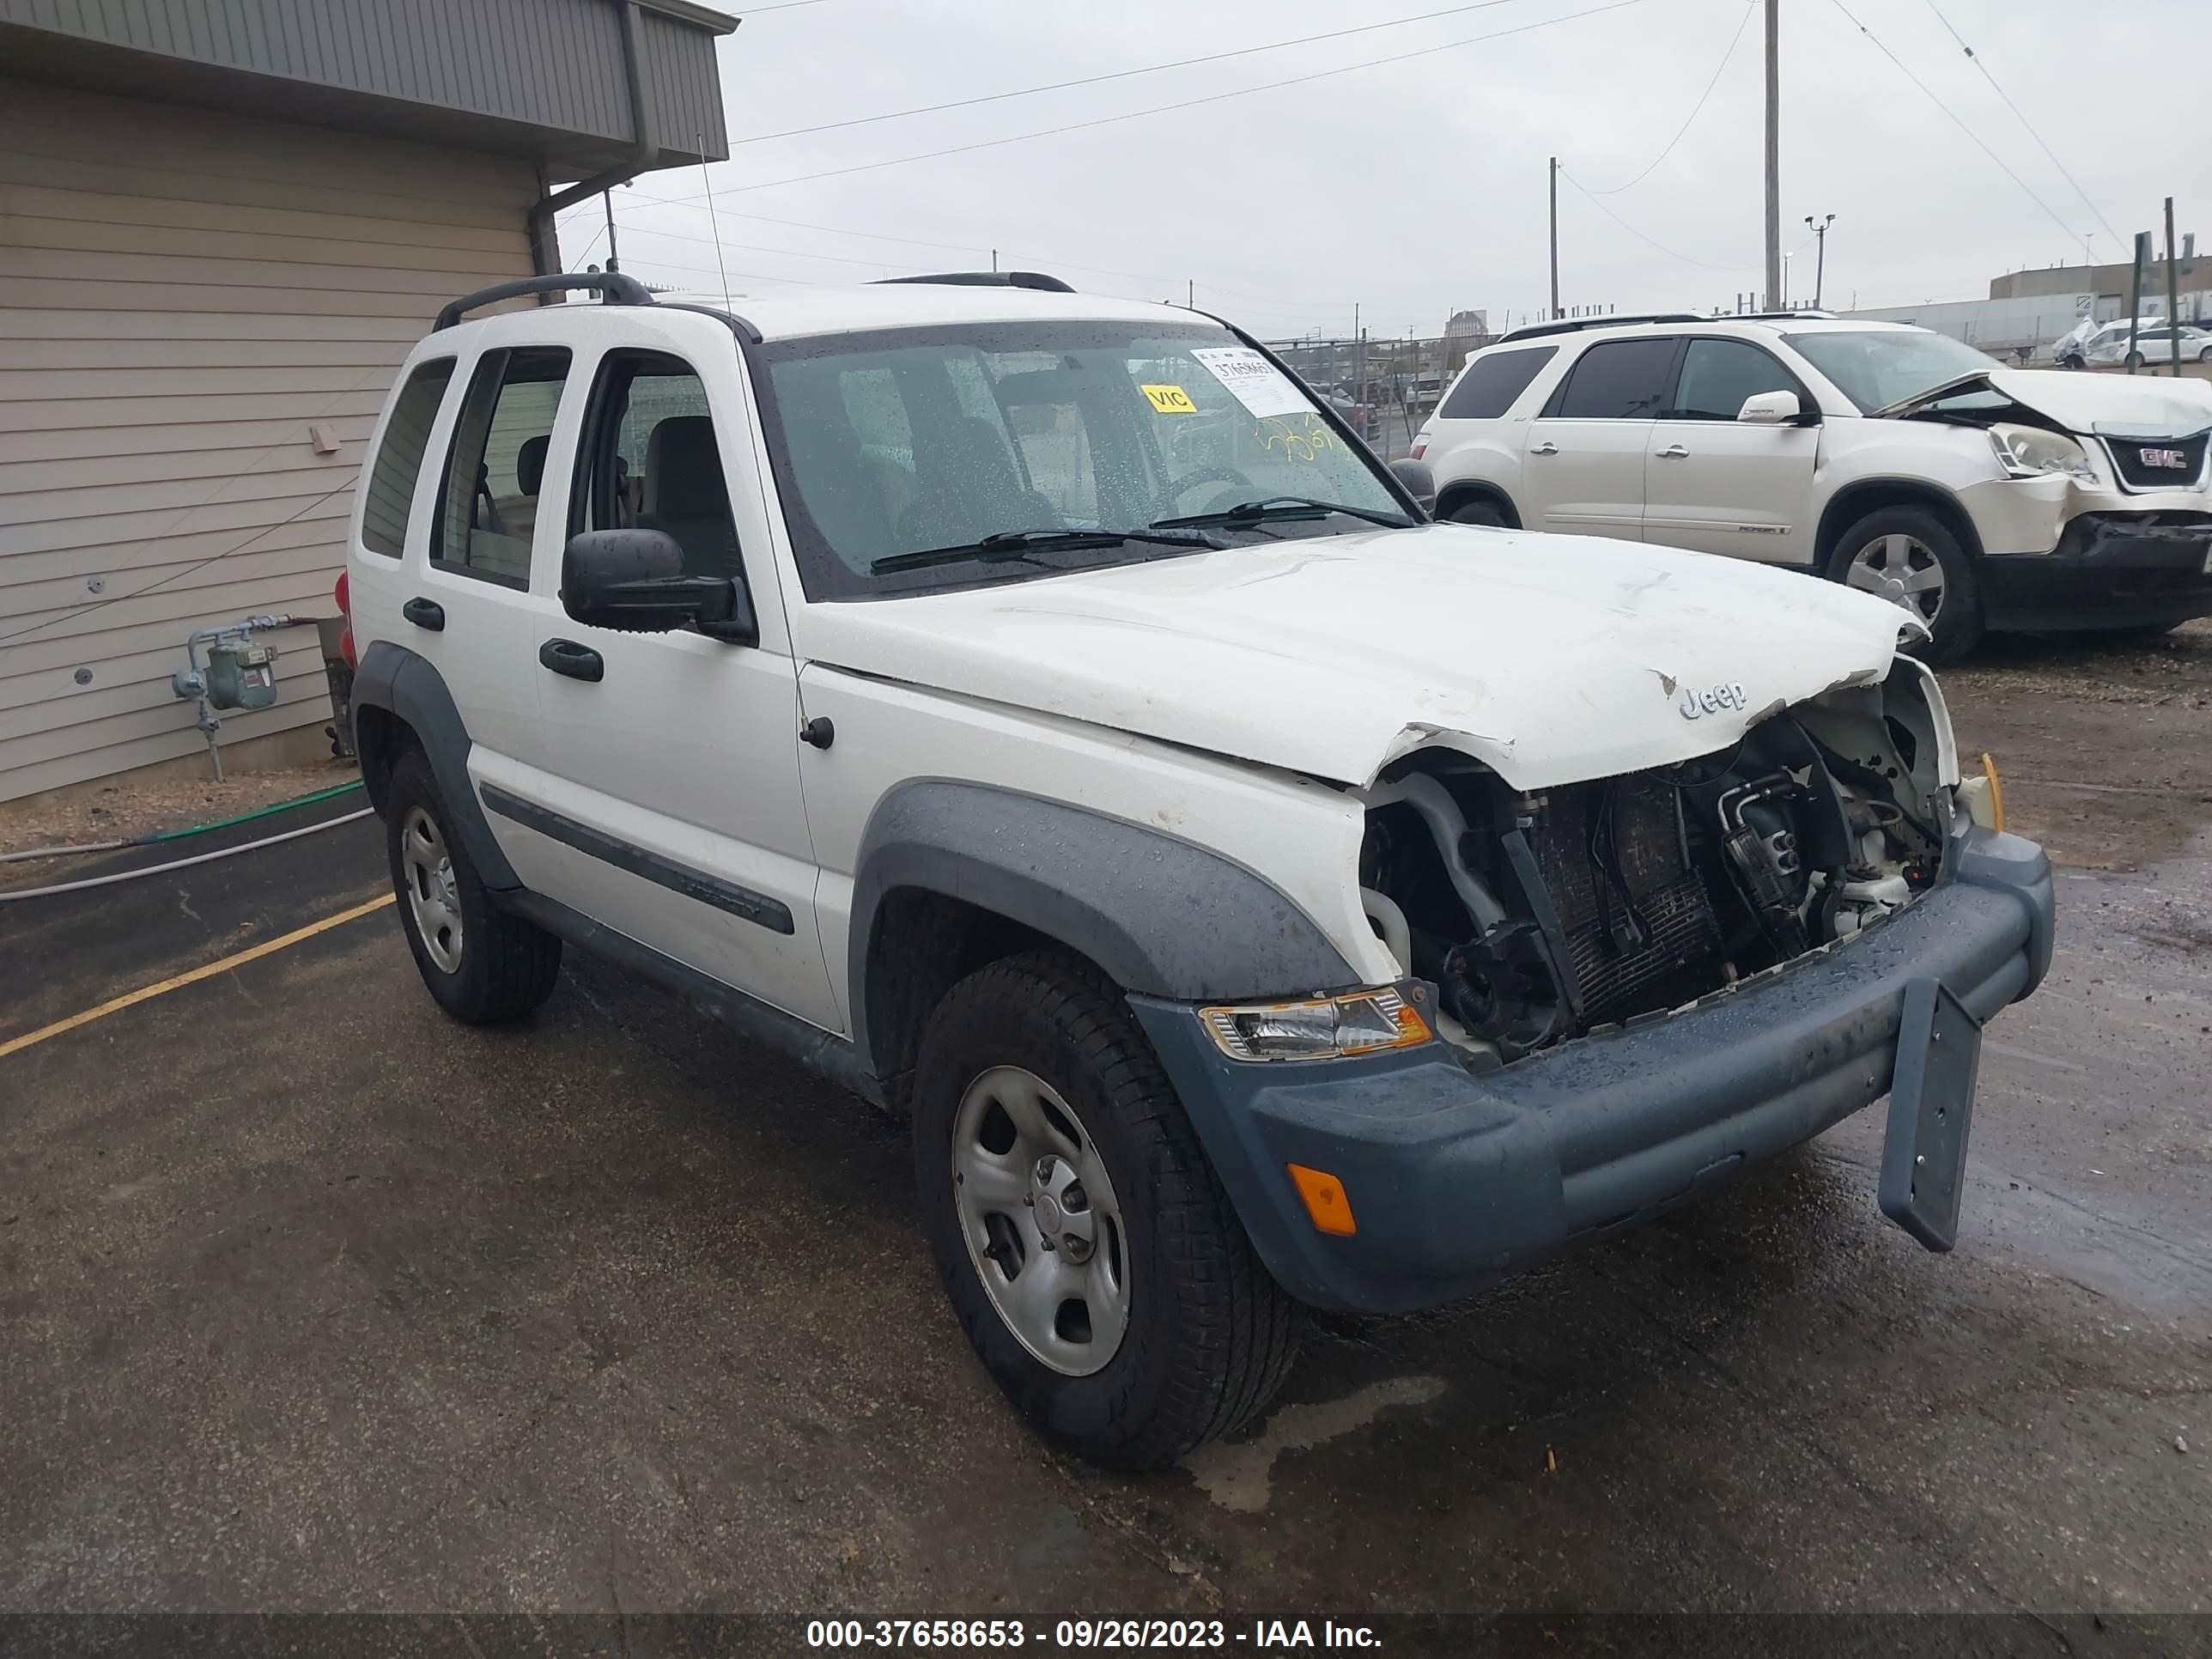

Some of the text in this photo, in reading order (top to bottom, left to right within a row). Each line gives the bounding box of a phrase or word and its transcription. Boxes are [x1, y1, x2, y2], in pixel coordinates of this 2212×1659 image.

[1149, 391, 1188, 407] VIC
[2140, 448, 2187, 469] GMC
[1680, 681, 1747, 720] Jeep
